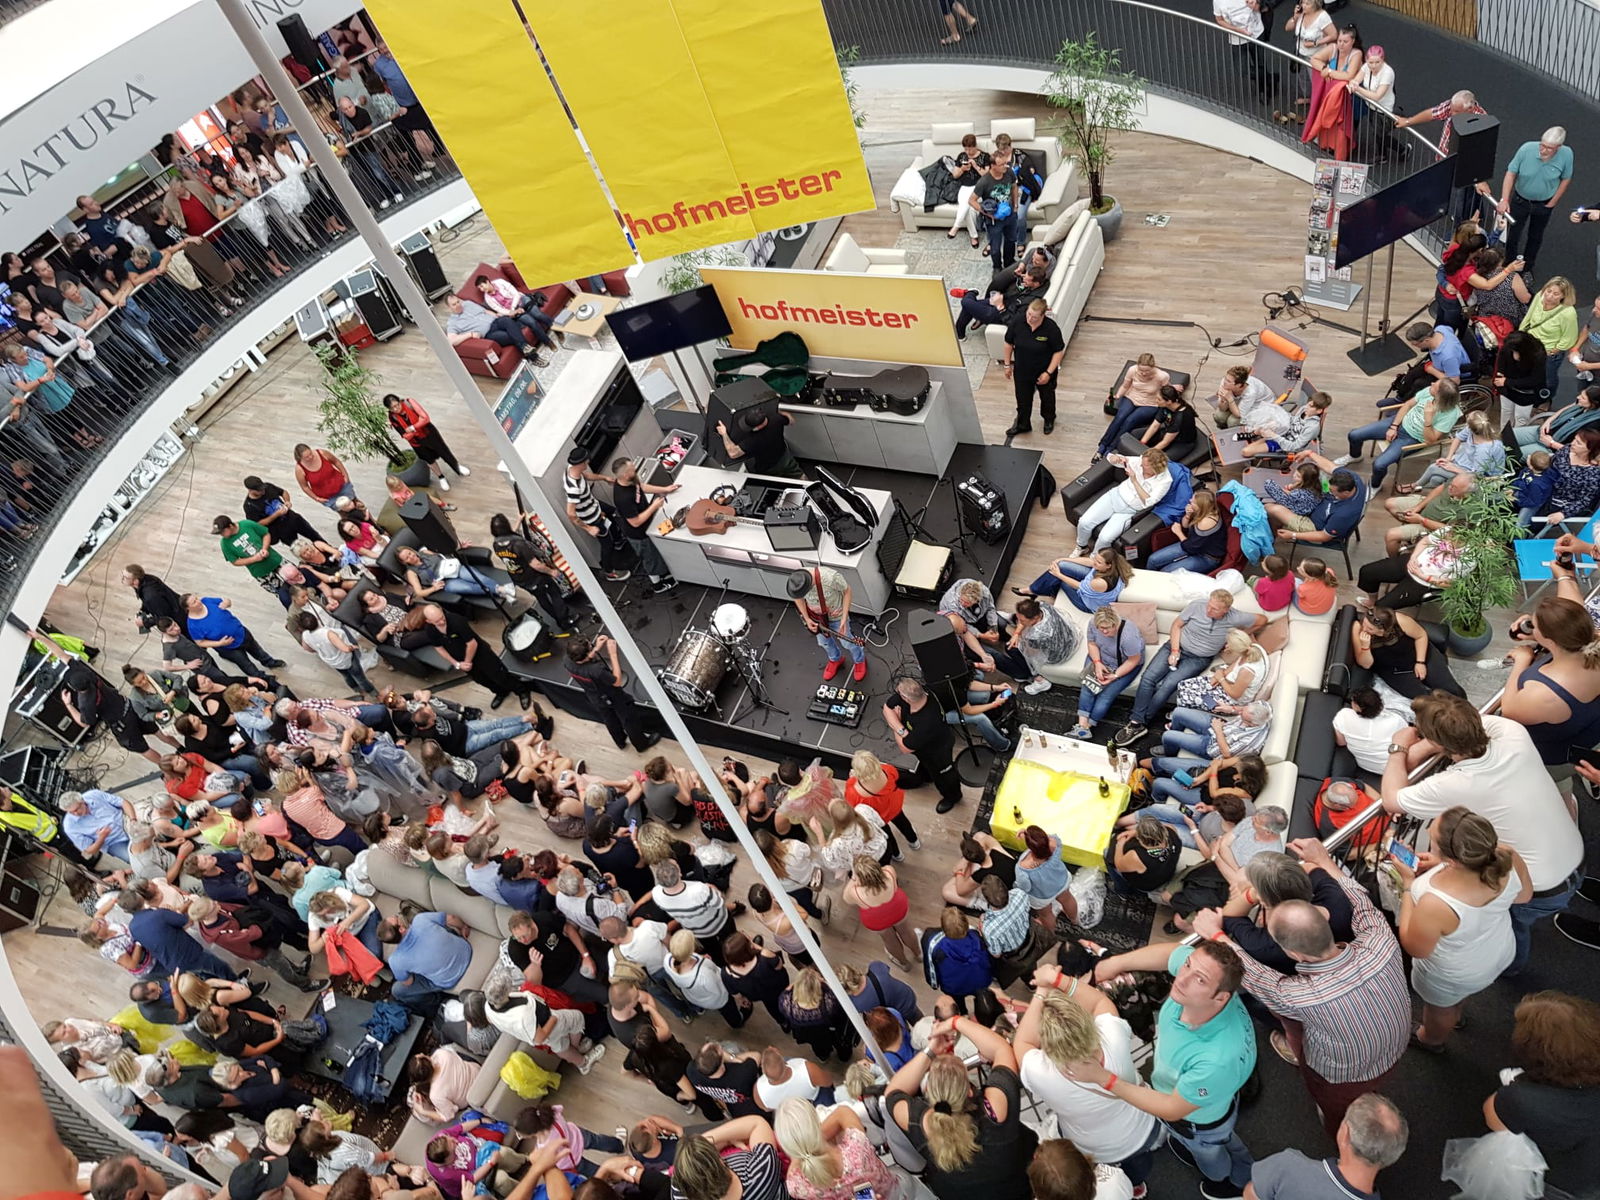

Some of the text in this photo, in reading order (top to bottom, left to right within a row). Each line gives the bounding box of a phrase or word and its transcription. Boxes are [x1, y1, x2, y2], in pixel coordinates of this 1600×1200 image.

[0, 82, 159, 215] NATURA
[622, 169, 842, 240] hofmeister
[737, 297, 919, 329] hofmeister
